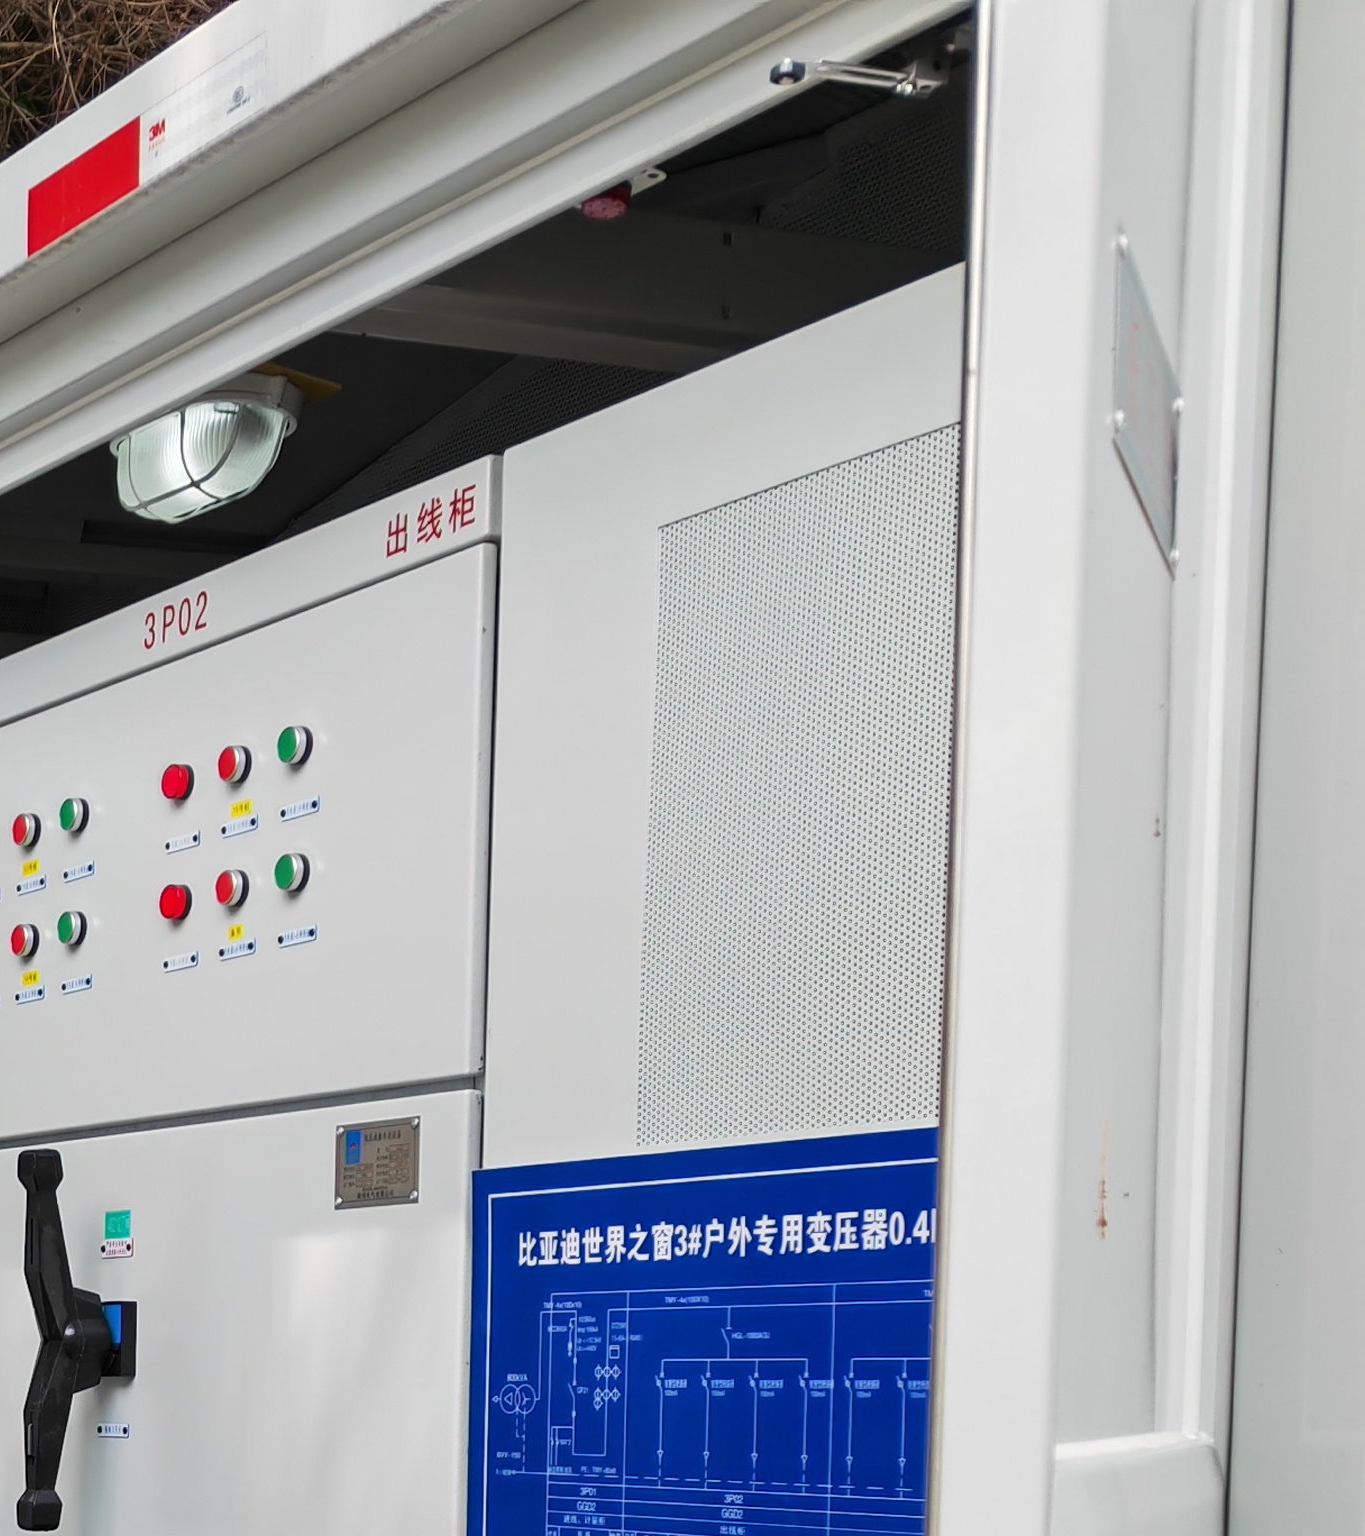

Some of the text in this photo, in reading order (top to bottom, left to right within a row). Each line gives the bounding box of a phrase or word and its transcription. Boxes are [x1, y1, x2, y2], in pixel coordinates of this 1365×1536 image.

[148, 118, 165, 142] 3M
[386, 484, 476, 558] 出线柜
[576, 1501, 597, 1512] GGD2
[721, 1508, 744, 1520] GGD2
